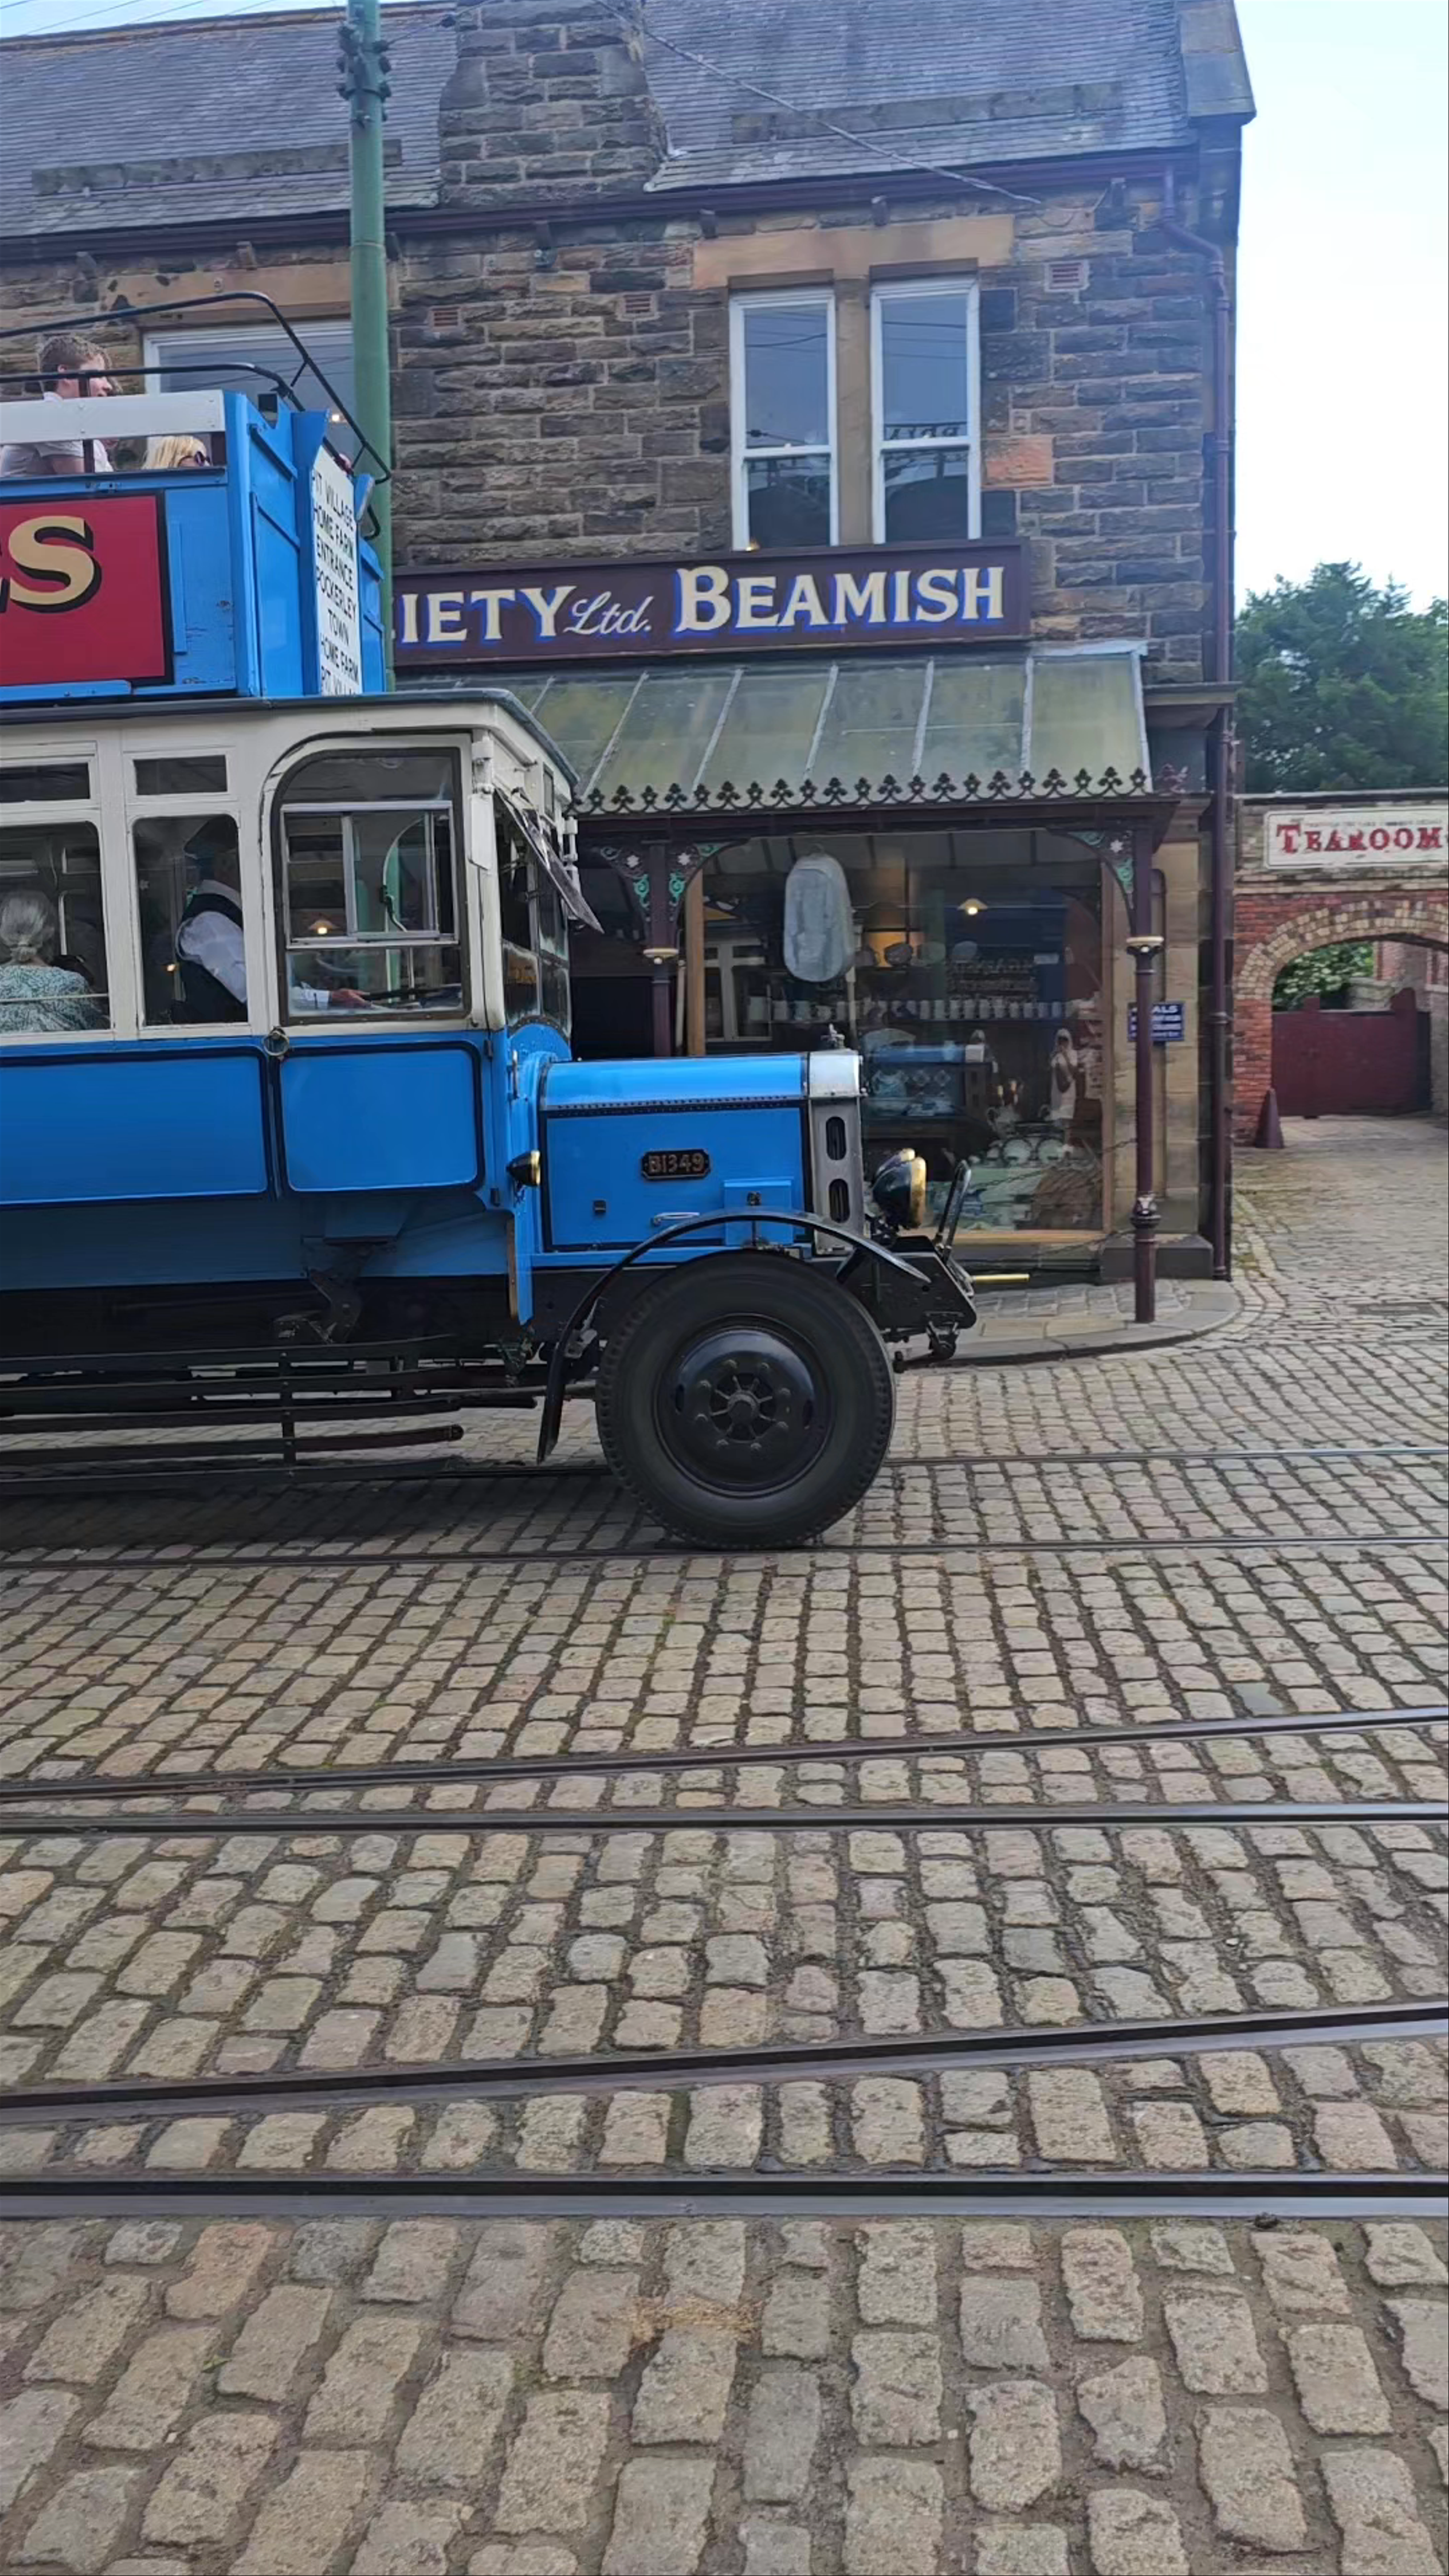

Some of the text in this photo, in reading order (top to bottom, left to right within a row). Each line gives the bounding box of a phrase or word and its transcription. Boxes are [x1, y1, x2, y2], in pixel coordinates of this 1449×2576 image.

[314, 503, 354, 561] HOME FARM
[325, 479, 354, 532] VILLAGE
[0, 515, 102, 613] S
[317, 534, 353, 590] ENTRANCE
[316, 566, 357, 622] POCKERLEY
[396, 566, 1004, 644] IETY Ltd. BEAMISH
[328, 607, 349, 646] TOWN
[320, 632, 359, 685] HOME FARM
[1277, 824, 1448, 854] TEAROOM
